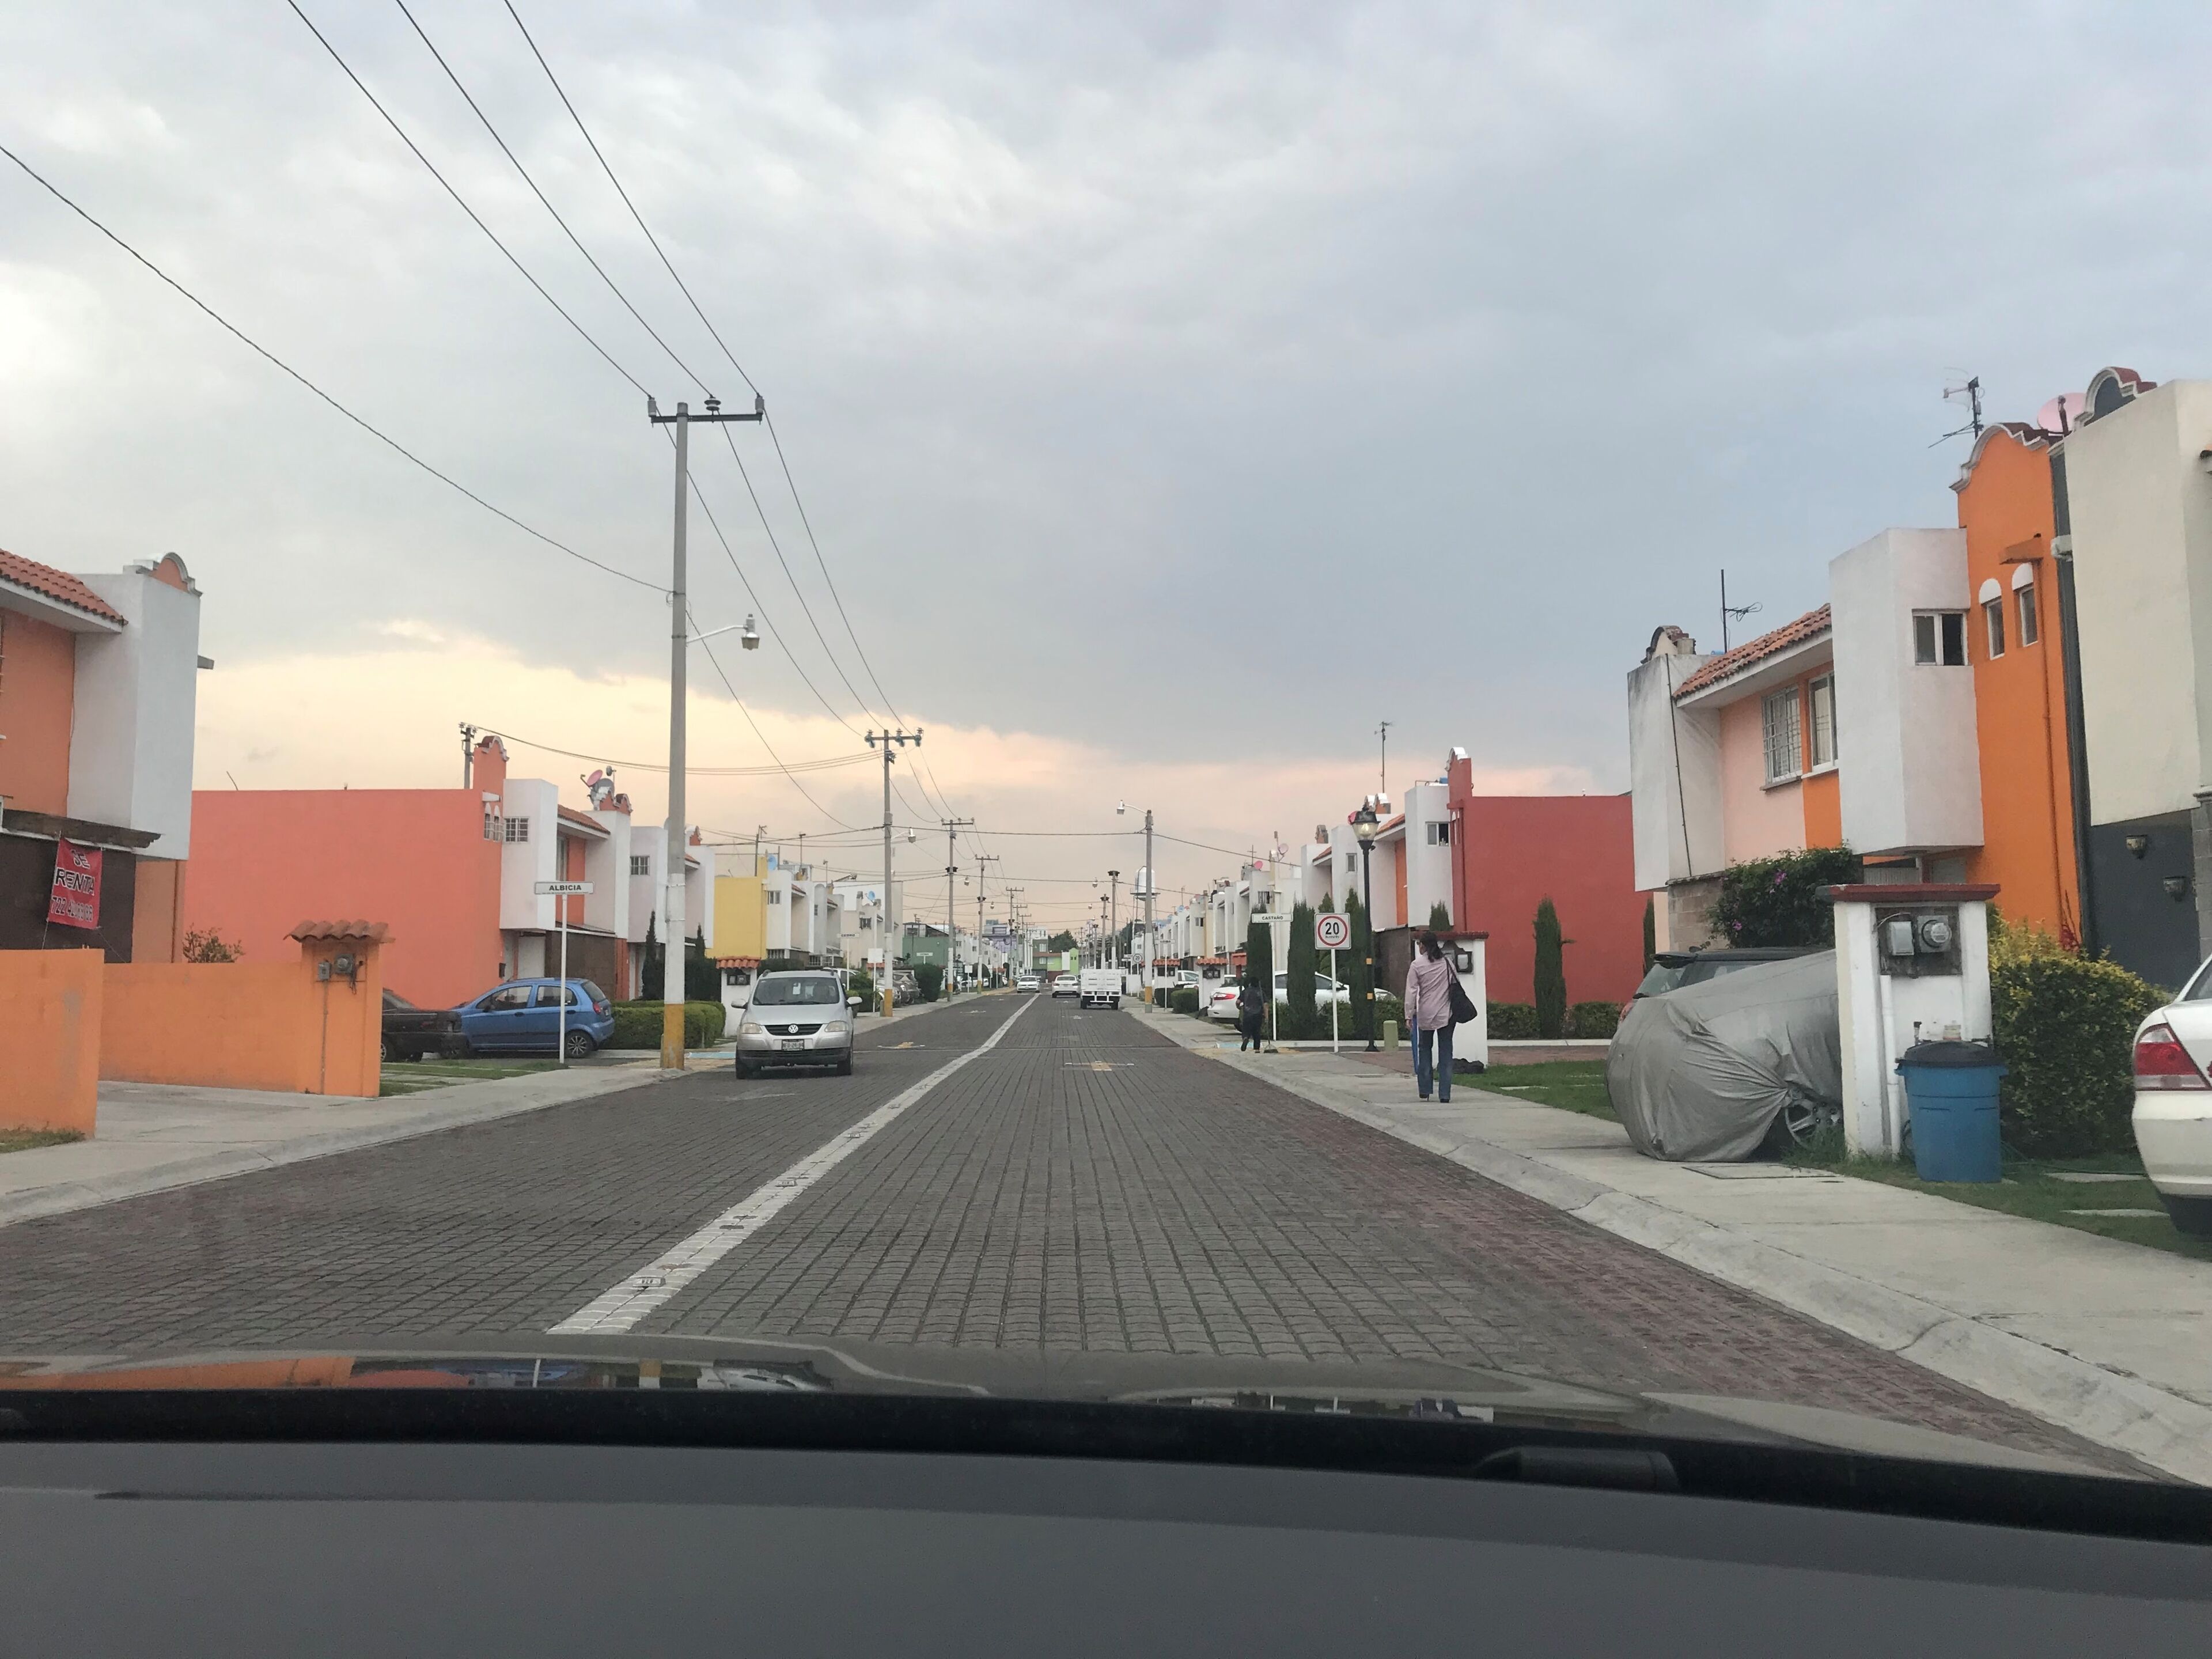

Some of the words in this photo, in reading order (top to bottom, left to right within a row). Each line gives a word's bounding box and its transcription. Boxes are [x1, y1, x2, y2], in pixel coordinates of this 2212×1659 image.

[71, 849, 90, 869] SE
[55, 867, 94, 896] RENTA
[1325, 922, 1339, 935] 20
